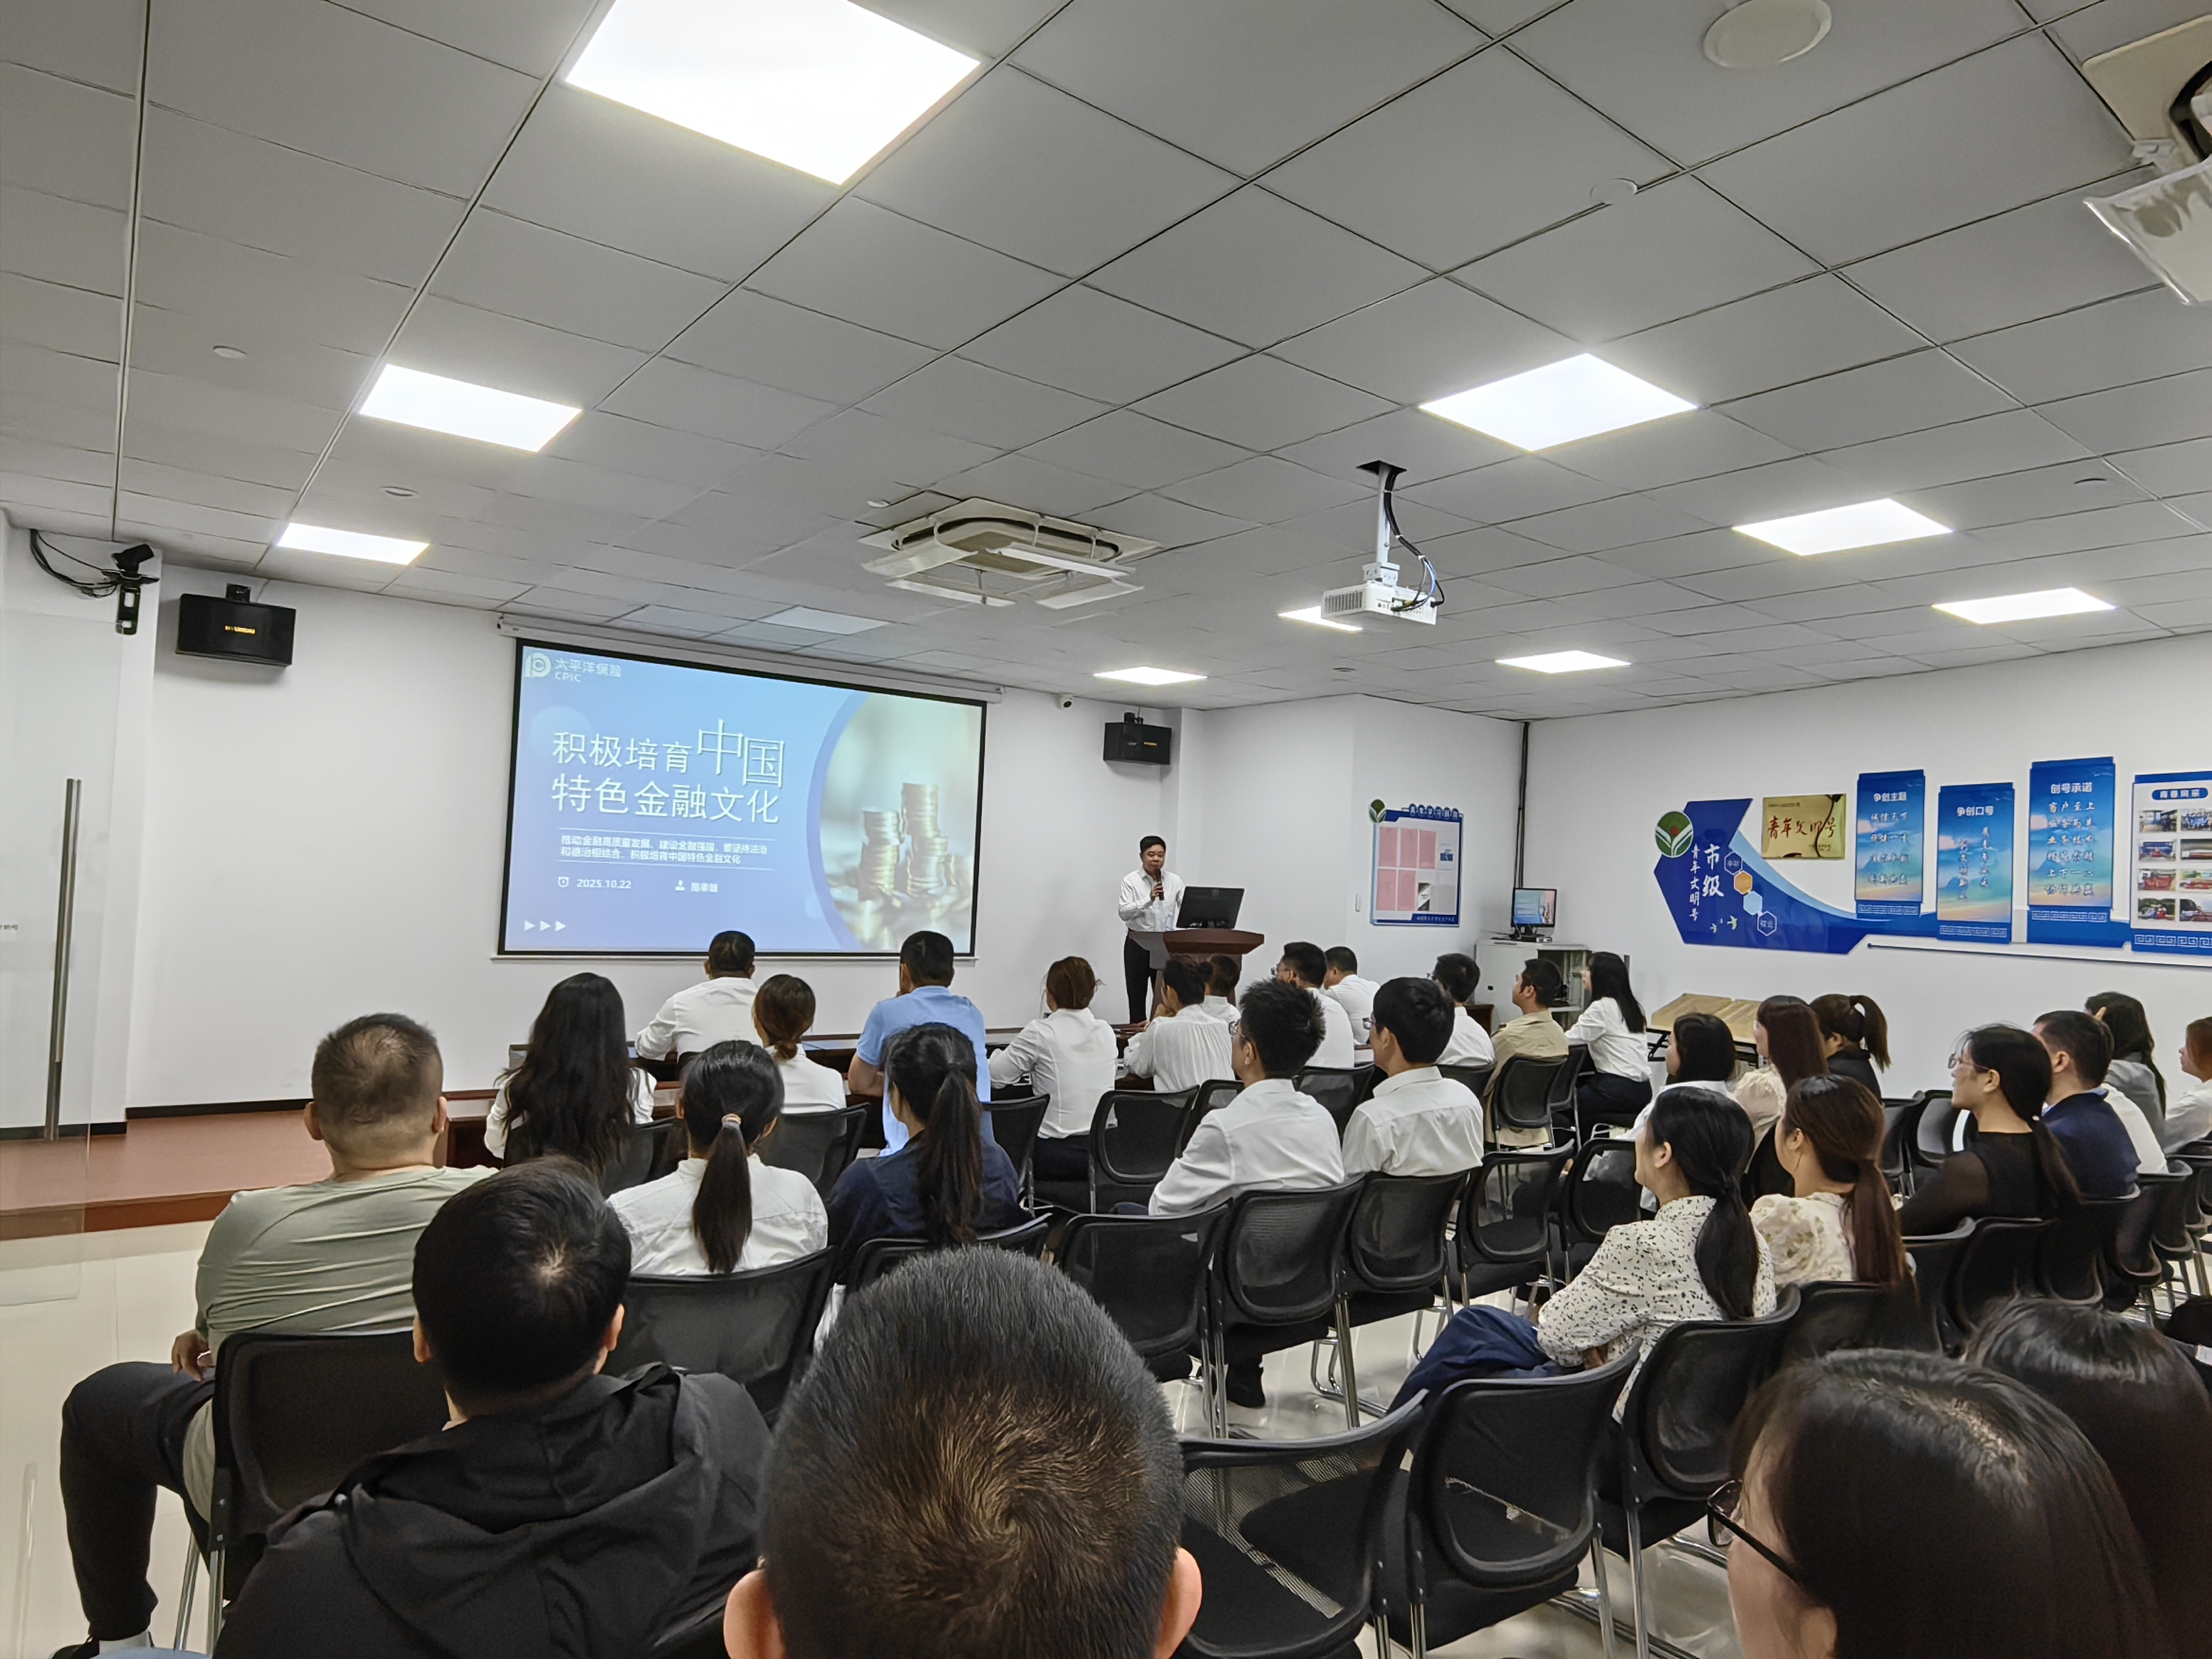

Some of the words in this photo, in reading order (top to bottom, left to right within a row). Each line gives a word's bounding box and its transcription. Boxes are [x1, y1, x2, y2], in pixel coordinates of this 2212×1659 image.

[555, 658, 622, 677] 太平洋保险
[555, 672, 581, 682] CPIC
[552, 719, 785, 788] 积极培育中国
[2051, 782, 2092, 794] 创号承诺
[552, 773, 779, 823] 特色金融文化
[1874, 791, 1907, 802] 争创主题
[1957, 806, 1994, 816] 争创口号
[2049, 802, 2095, 813] 客户至上
[1768, 815, 1836, 840] 青年文明号
[1702, 843, 1724, 897] 市级
[577, 879, 631, 890] 2025.10.22
[1689, 843, 1700, 922] 青年文明号
